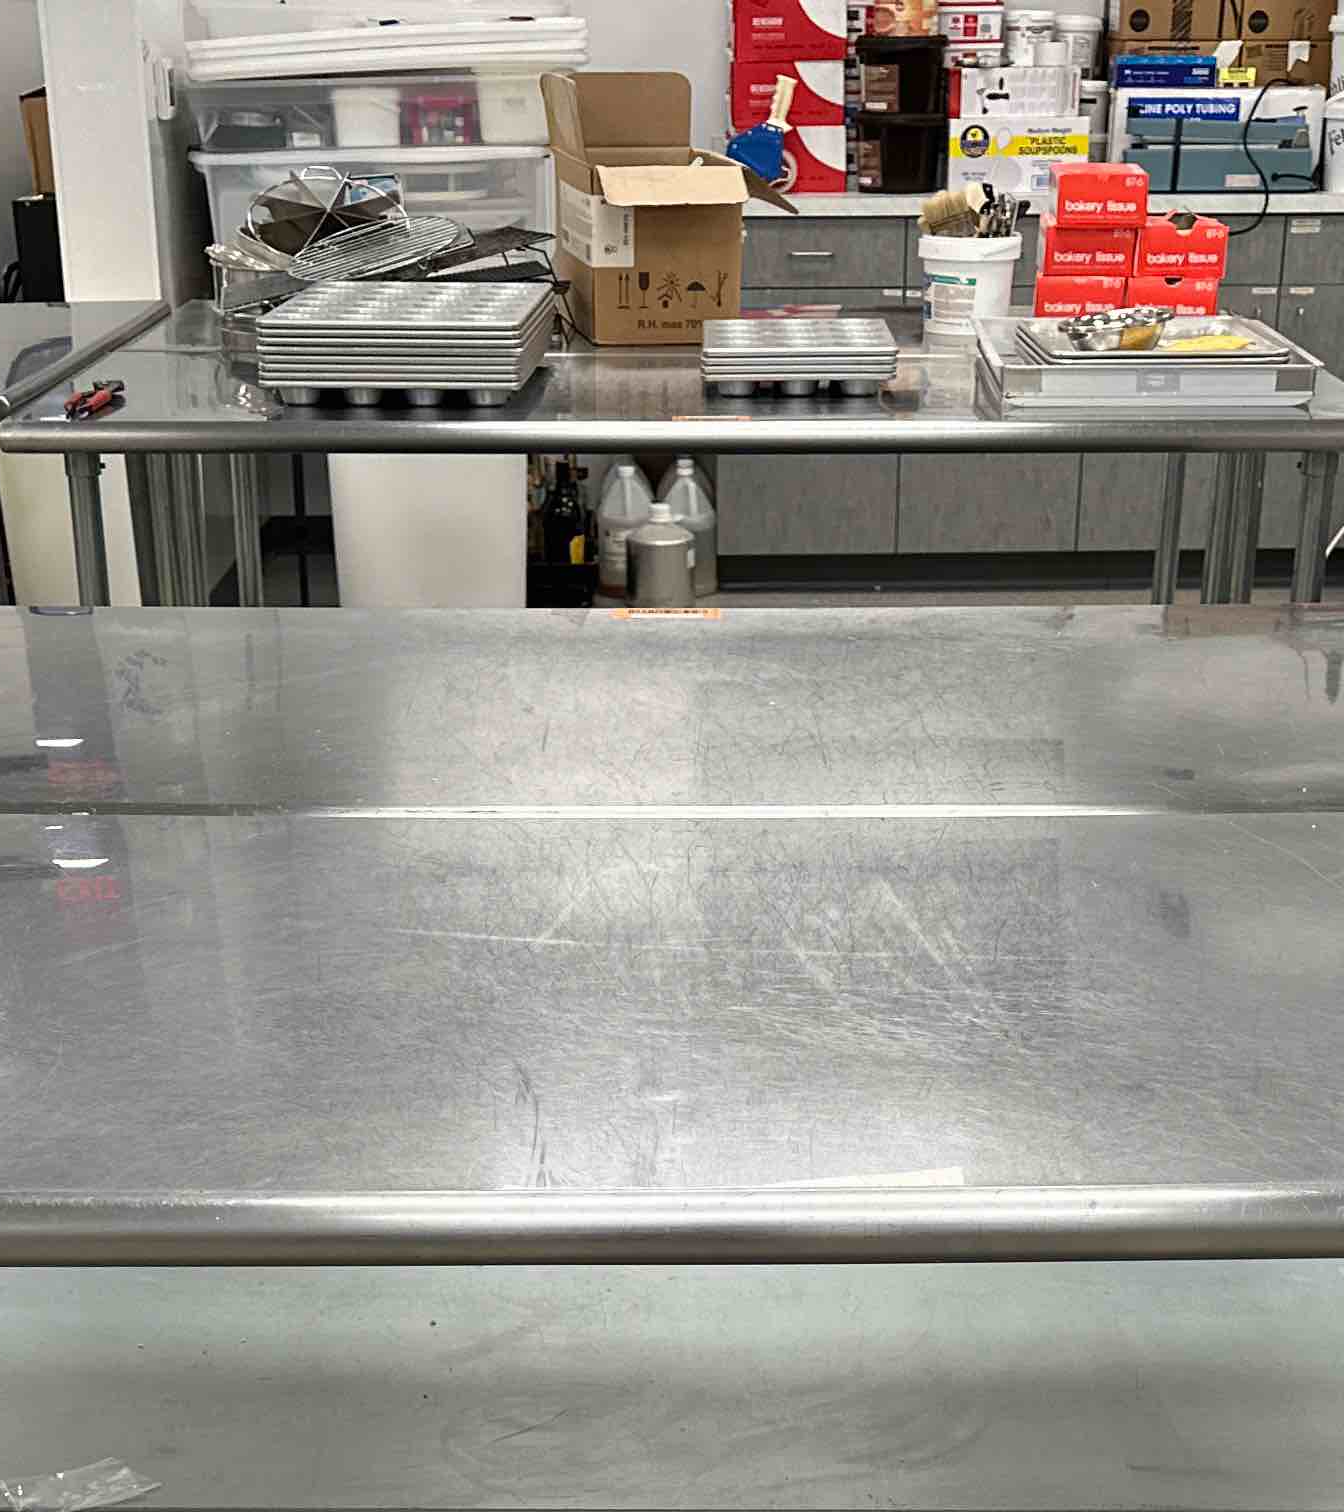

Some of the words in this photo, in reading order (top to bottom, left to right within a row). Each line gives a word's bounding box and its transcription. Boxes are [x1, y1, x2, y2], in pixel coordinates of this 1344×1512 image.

[1164, 103, 1193, 114] POLY
[1196, 103, 1236, 114] TUBING
[1065, 200, 1104, 213] bakery
[1107, 200, 1137, 212] tissue
[1053, 251, 1092, 264] bakery
[1096, 251, 1126, 263] tissue
[1146, 253, 1185, 266] bakery
[1188, 252, 1219, 263] tissue
[1044, 301, 1082, 314] bakery
[1176, 303, 1207, 315] tissue
